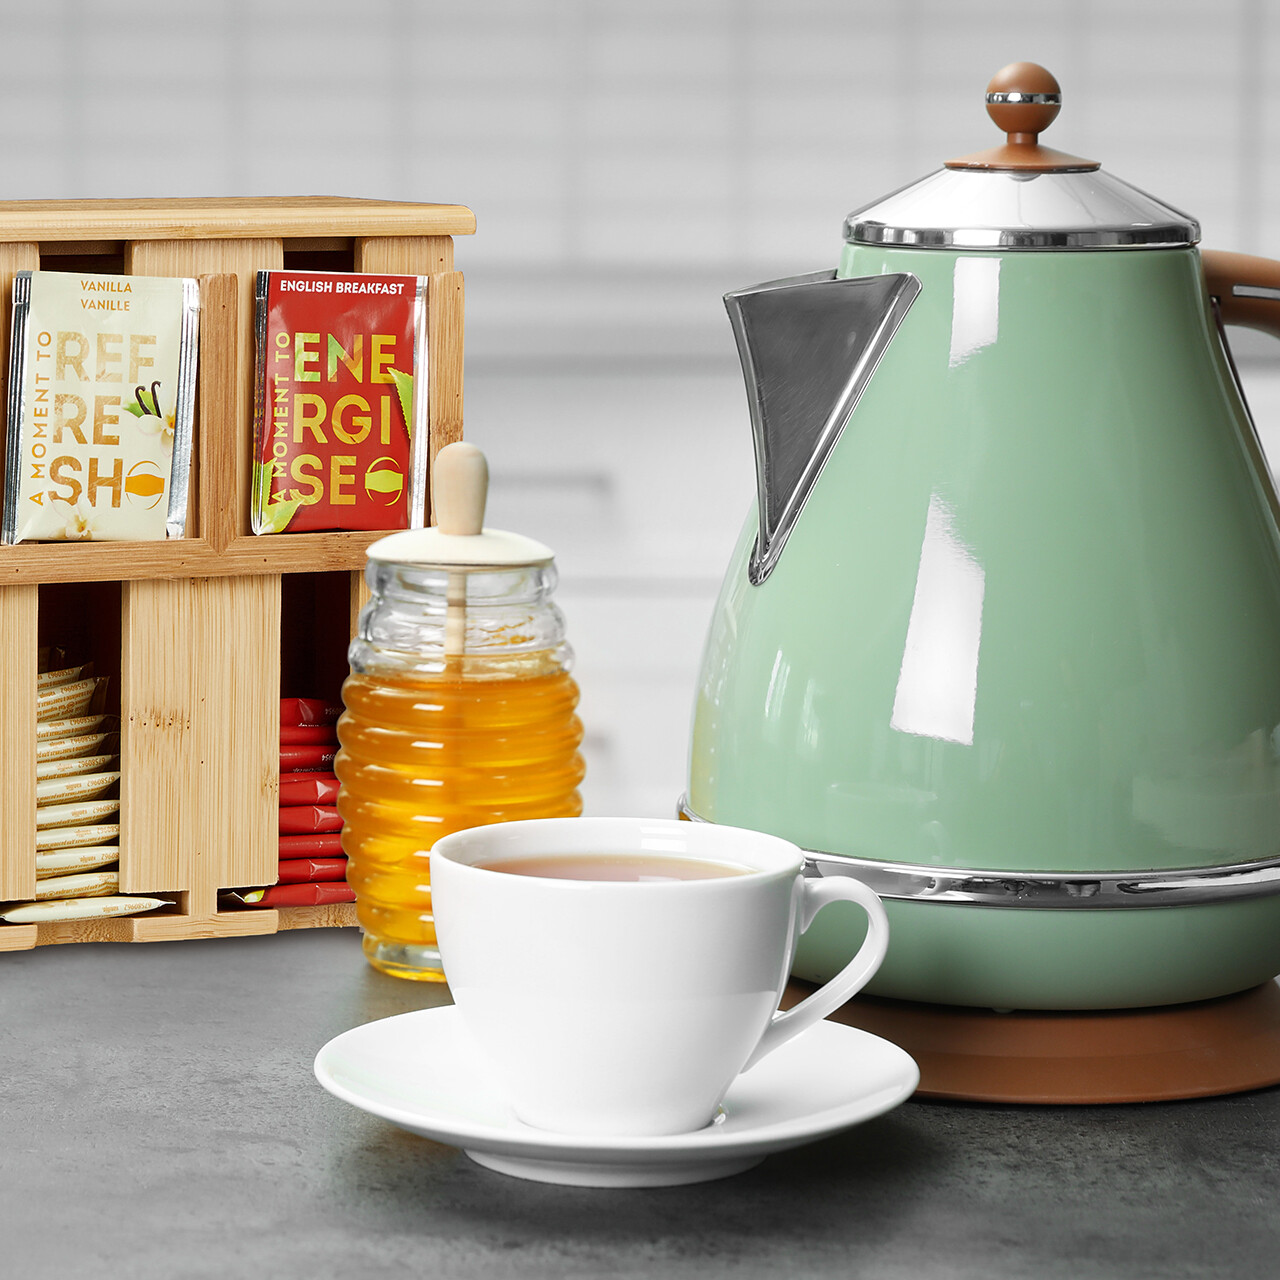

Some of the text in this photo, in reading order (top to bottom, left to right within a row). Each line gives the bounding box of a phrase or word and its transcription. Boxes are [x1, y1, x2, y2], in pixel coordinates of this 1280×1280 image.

[80, 280, 132, 293] VANILLA
[80, 299, 130, 311] VANILLE
[280, 280, 405, 295] ENGLISH BREAKFAST
[55, 330, 157, 384] REF
[294, 332, 397, 384] ENE
[29, 331, 52, 506] A MOMENT TO
[52, 393, 121, 445] RE
[270, 332, 291, 505] A MOMENT TO
[292, 393, 390, 445] RGI
[48, 455, 123, 508] SH
[290, 453, 357, 506] SE
[60, 682, 88, 694] 67580962
[124, 901, 152, 911] 67580962
